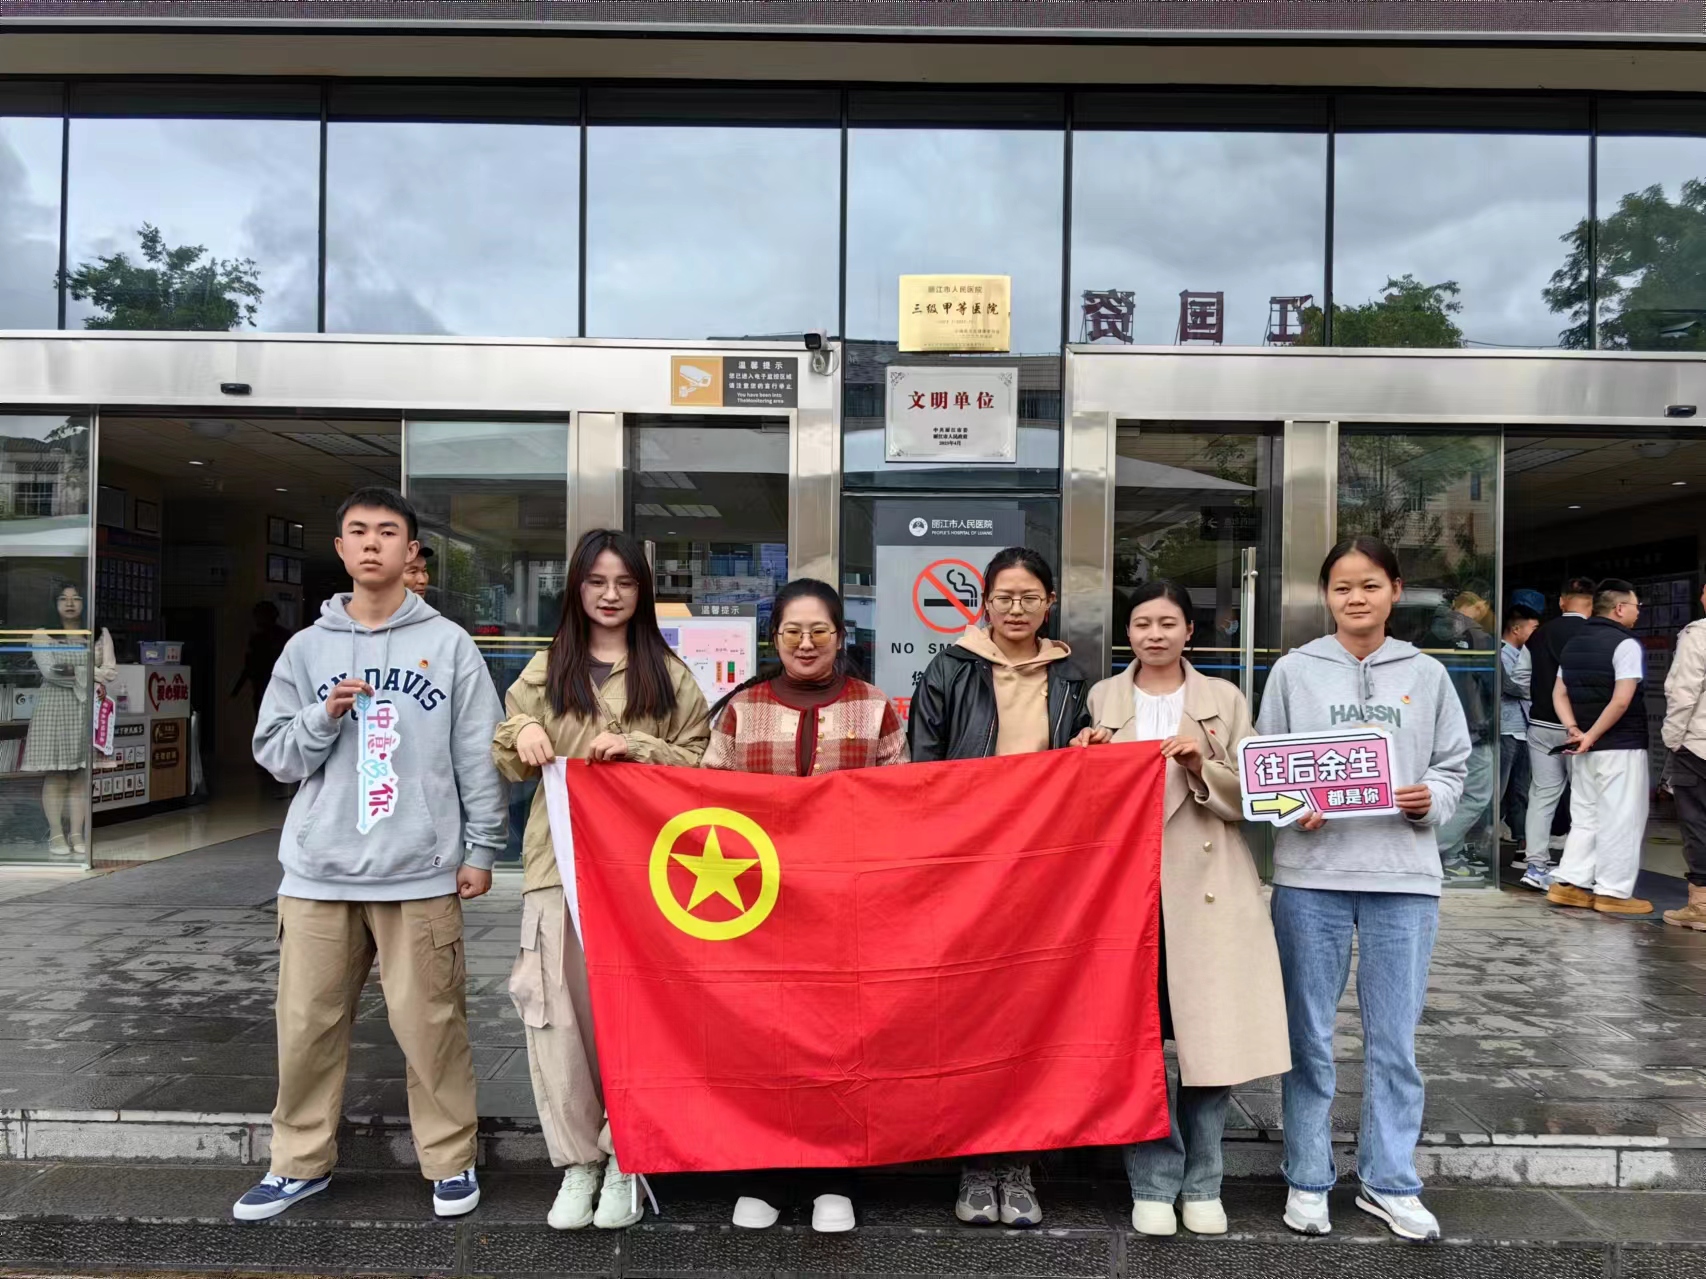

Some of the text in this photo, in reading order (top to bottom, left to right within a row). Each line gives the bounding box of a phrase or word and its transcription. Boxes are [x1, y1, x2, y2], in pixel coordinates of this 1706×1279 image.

[927, 285, 983, 294] 丽江市人民医院
[911, 302, 999, 315] 三级甲等医院
[738, 361, 783, 369] 温馨提示
[728, 382, 793, 390] 请注意您的言行举止
[907, 391, 994, 409] 文明单位
[931, 519, 993, 529] 丽江市人民医院
[701, 605, 740, 615] 温馨提示
[891, 643, 914, 654] NO
[364, 668, 447, 711] DAVIS
[1254, 747, 1380, 786] 往后余生
[1327, 787, 1380, 806] 都是你
